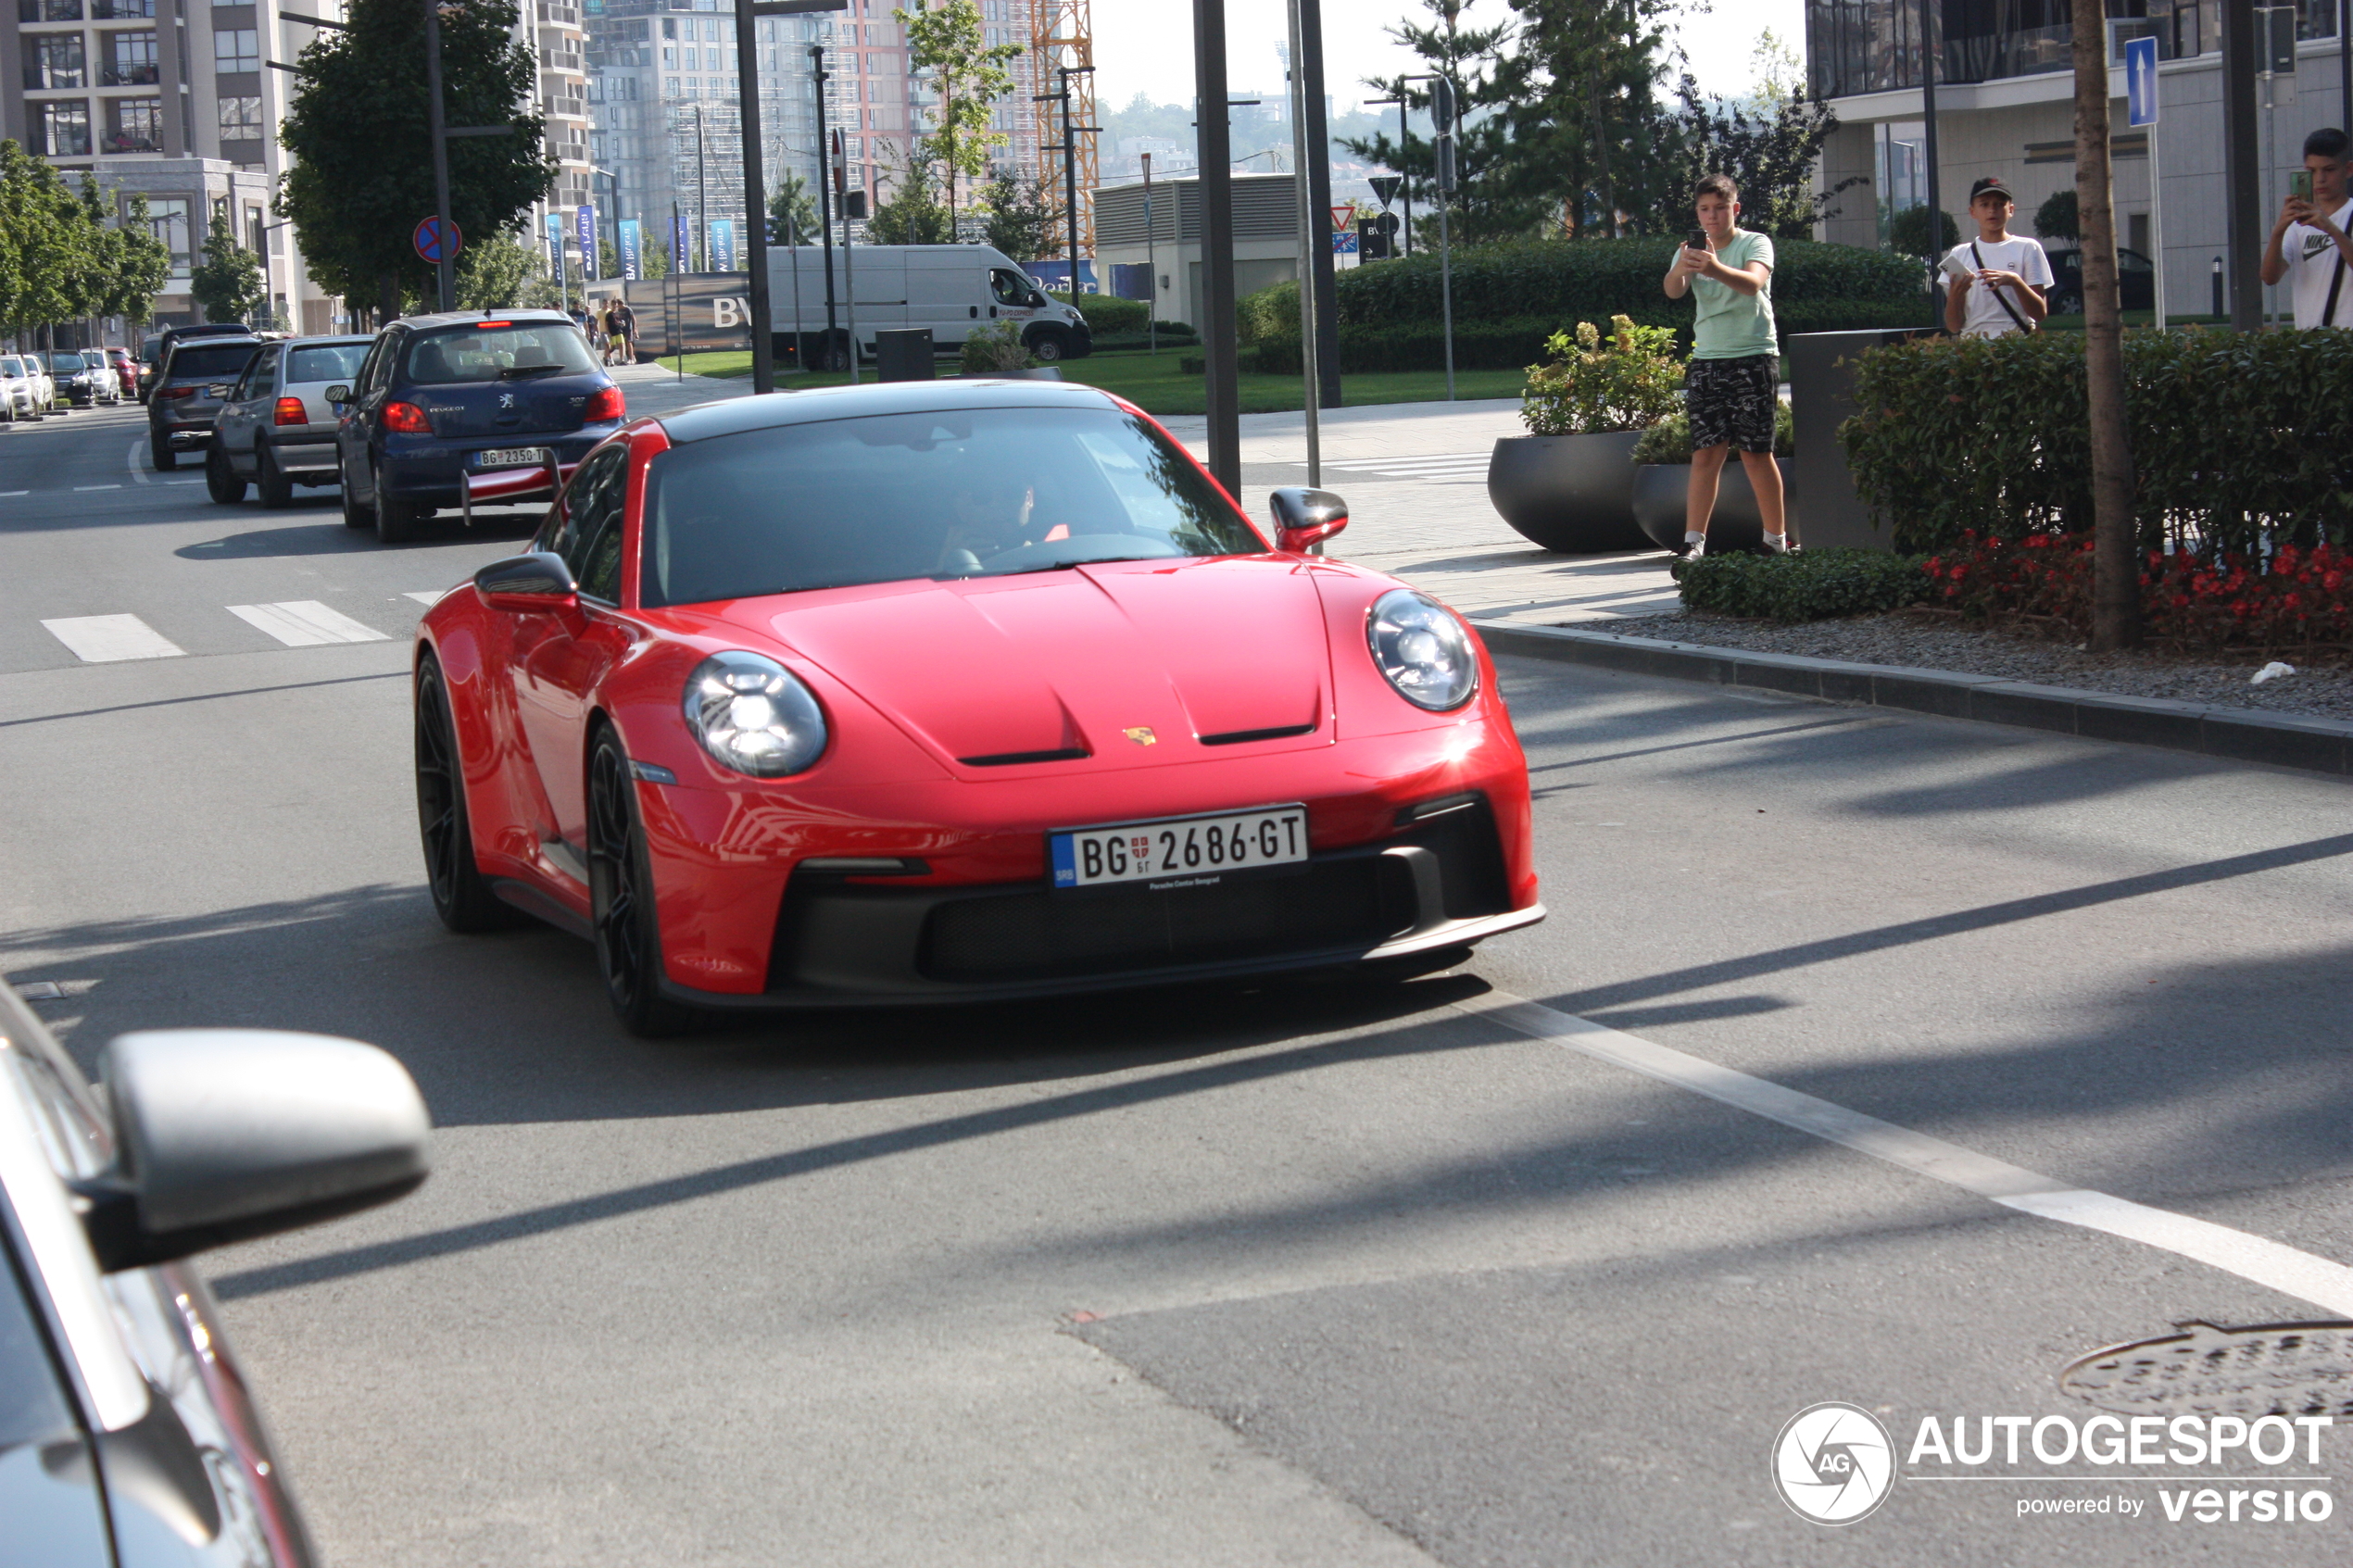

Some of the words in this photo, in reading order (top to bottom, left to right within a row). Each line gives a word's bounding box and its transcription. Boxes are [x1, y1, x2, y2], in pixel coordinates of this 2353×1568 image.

[2304, 233, 2331, 249] NIKE
[482, 452, 497, 464] BG
[1082, 835, 1126, 879] BG
[1056, 869, 1074, 881] SRB
[1149, 882, 1174, 890] Porsche
